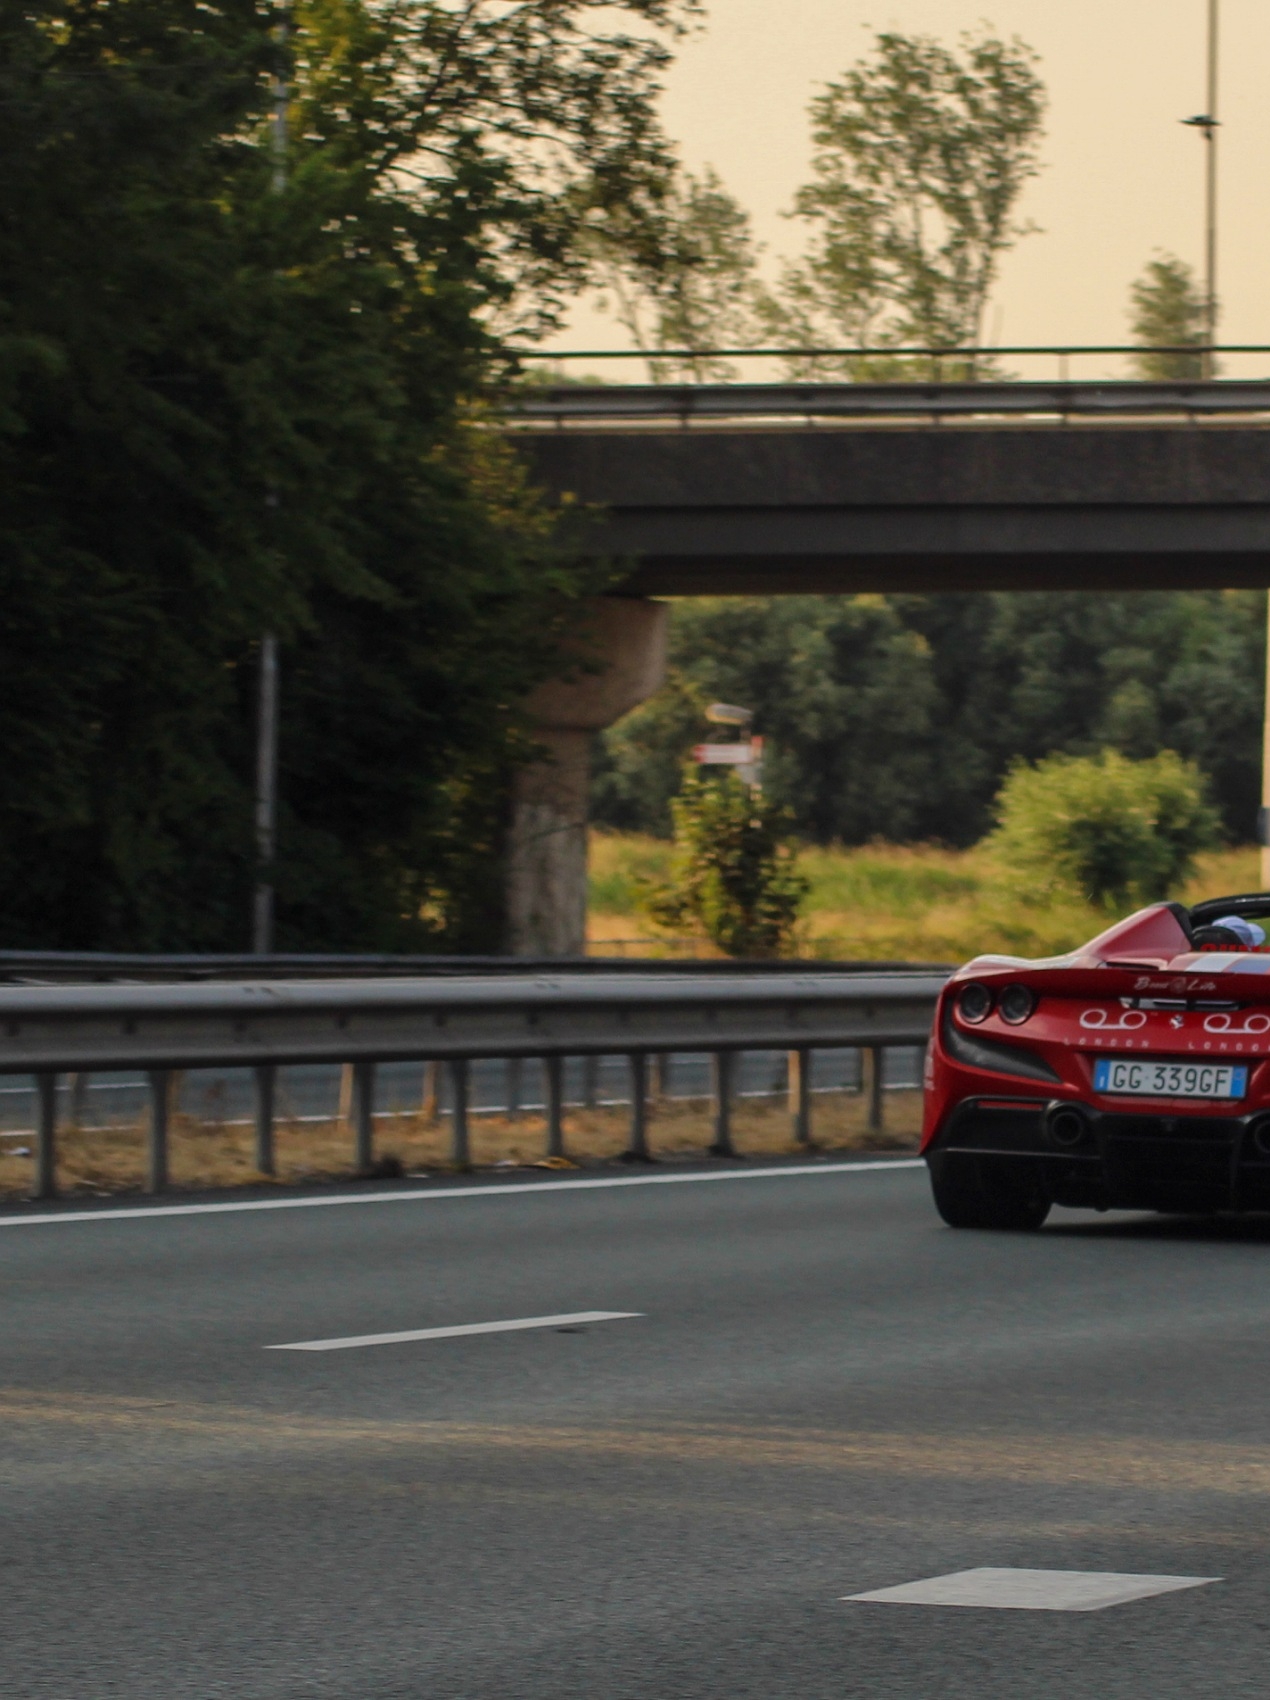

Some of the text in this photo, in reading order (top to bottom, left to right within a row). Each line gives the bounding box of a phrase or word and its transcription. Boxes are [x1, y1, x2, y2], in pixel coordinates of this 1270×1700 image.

[1064, 1037, 1150, 1049] LONDON
[1113, 1064, 1229, 1094] GG 339GF
